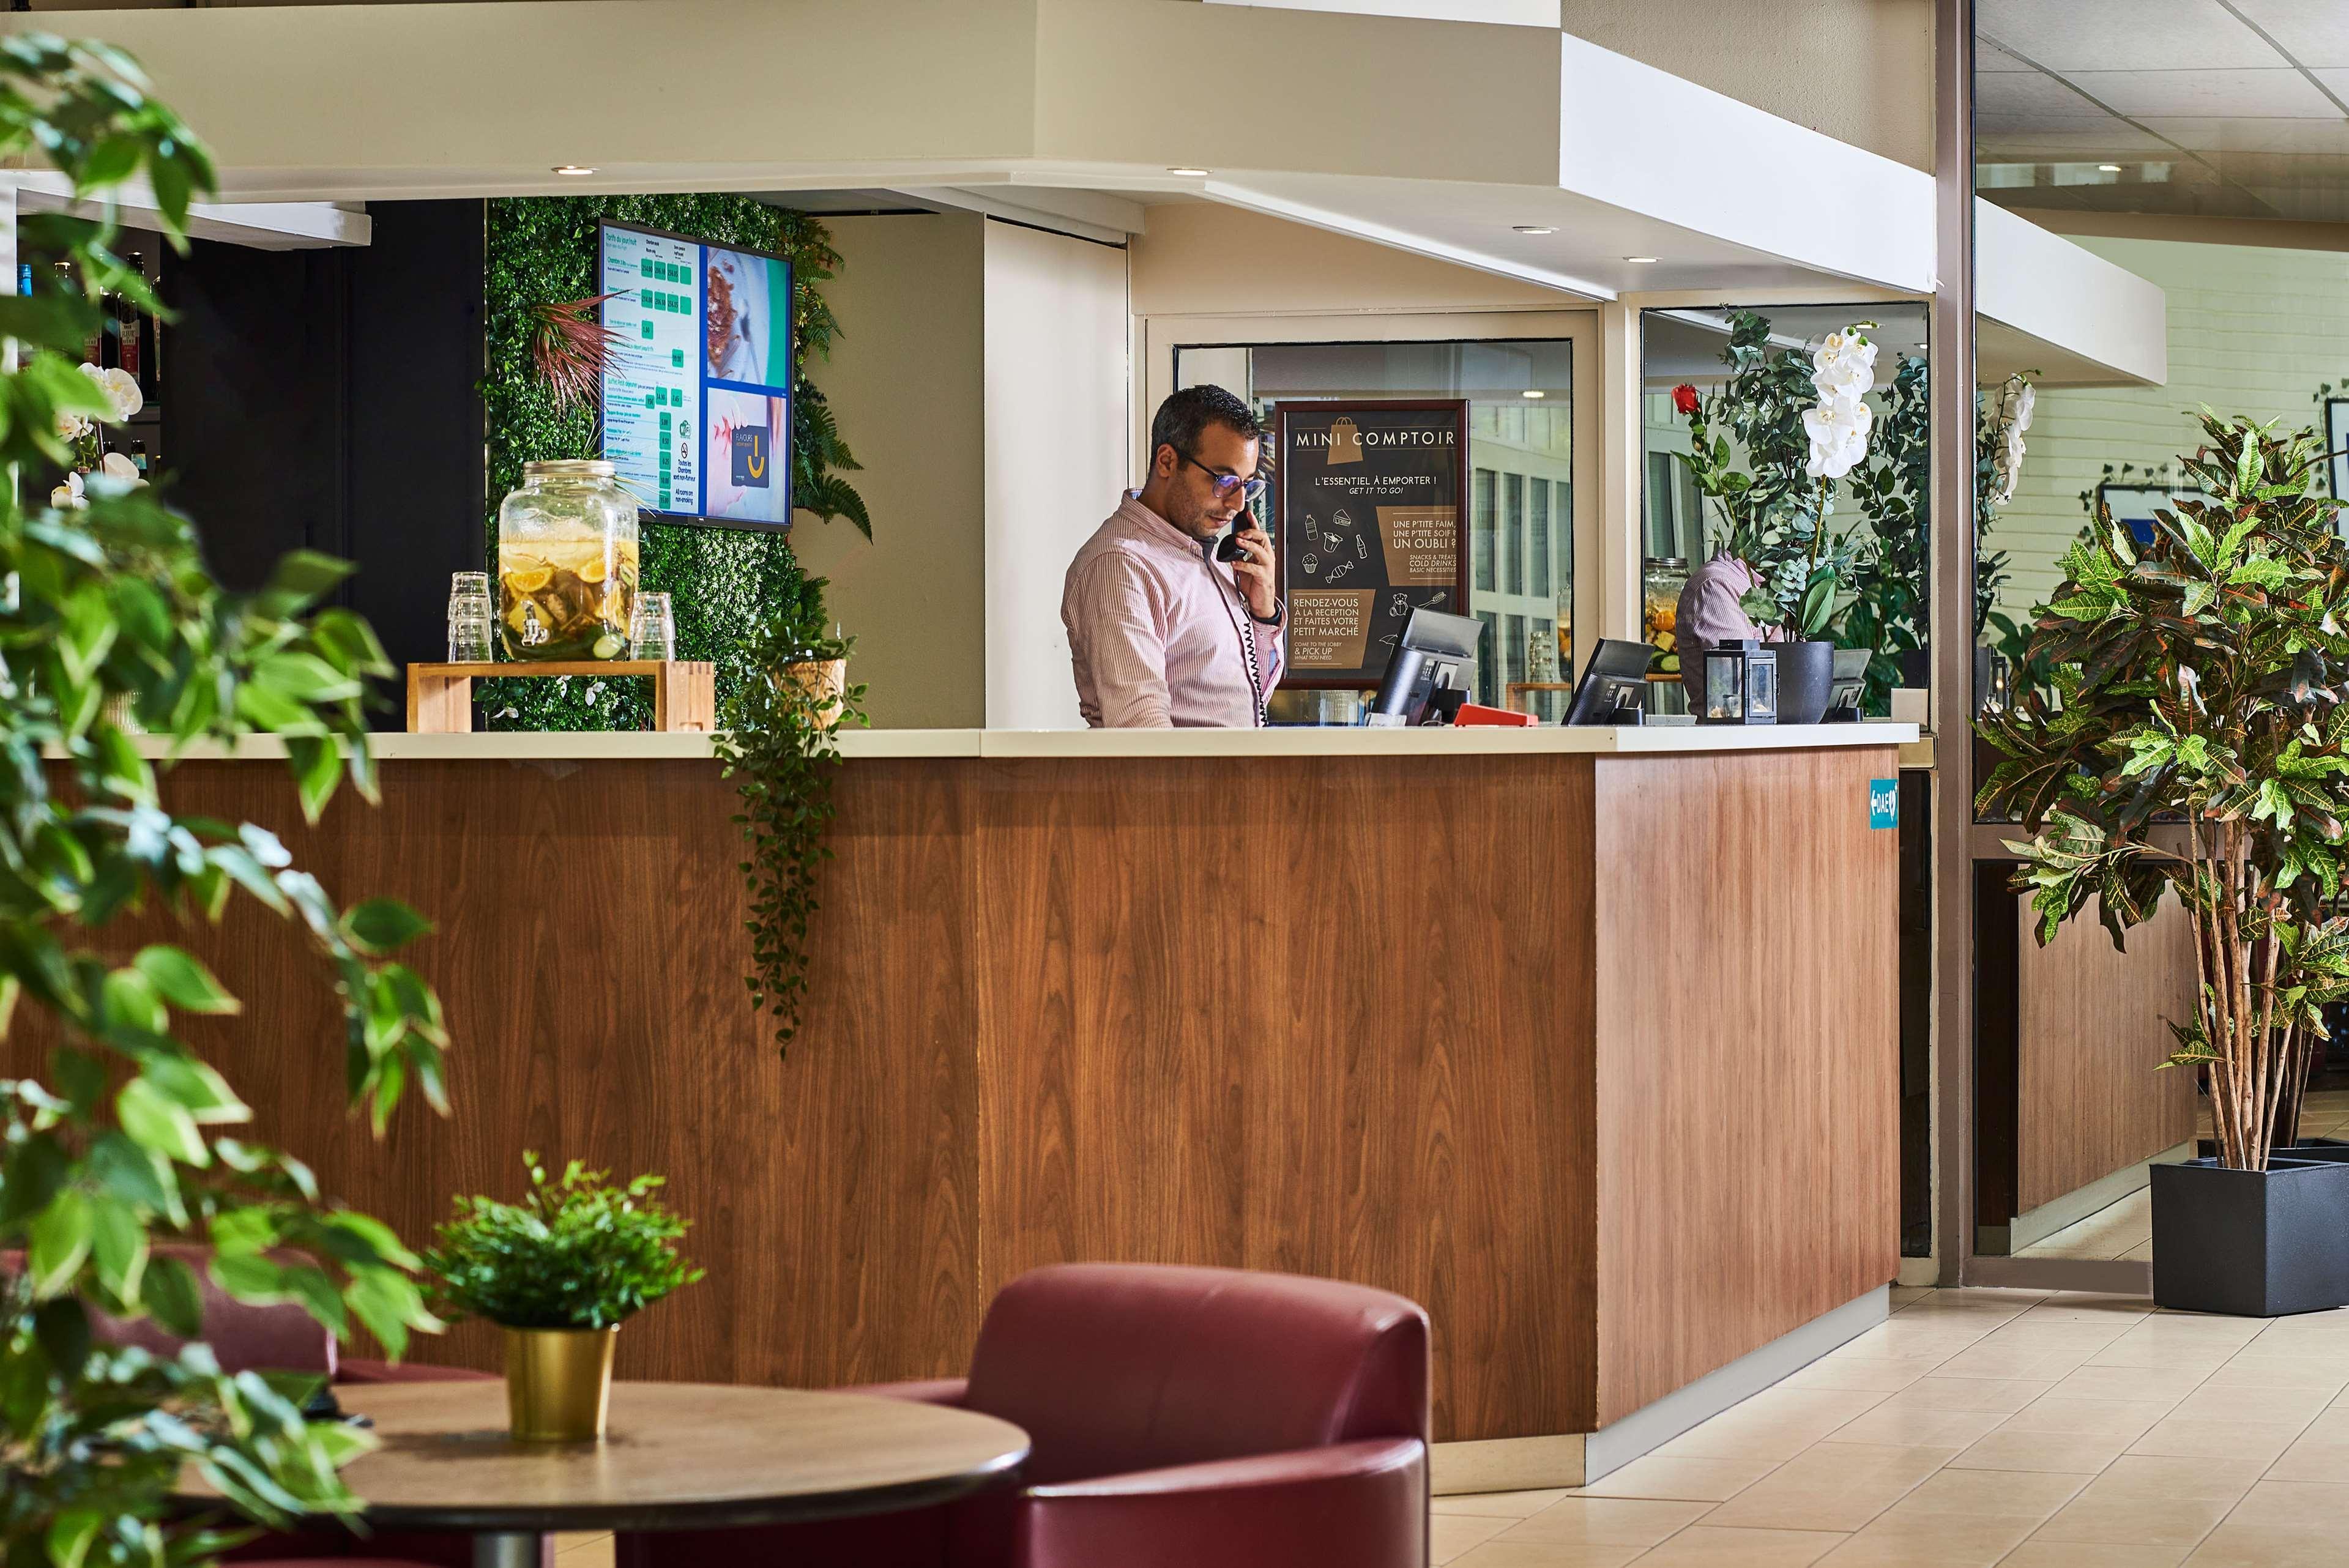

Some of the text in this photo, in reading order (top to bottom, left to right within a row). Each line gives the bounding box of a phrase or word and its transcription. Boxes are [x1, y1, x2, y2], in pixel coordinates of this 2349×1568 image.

[1296, 432, 1454, 446] MINI COMPTOIR
[1315, 477, 1370, 486] L'ESSENTIEL
[1374, 475, 1380, 485] À
[1383, 477, 1431, 485] EMPORTER
[676, 497, 693, 505] non-smoking
[1435, 520, 1456, 529] FAIM,
[1393, 538, 1410, 549] UN
[1415, 538, 1447, 549] OUBLI
[1294, 598, 1358, 608] RENDEZ-VOUS
[1295, 607, 1301, 616] À
[1294, 625, 1358, 636] PETIT MARCHÉ
[1877, 793, 1889, 813] DAE
